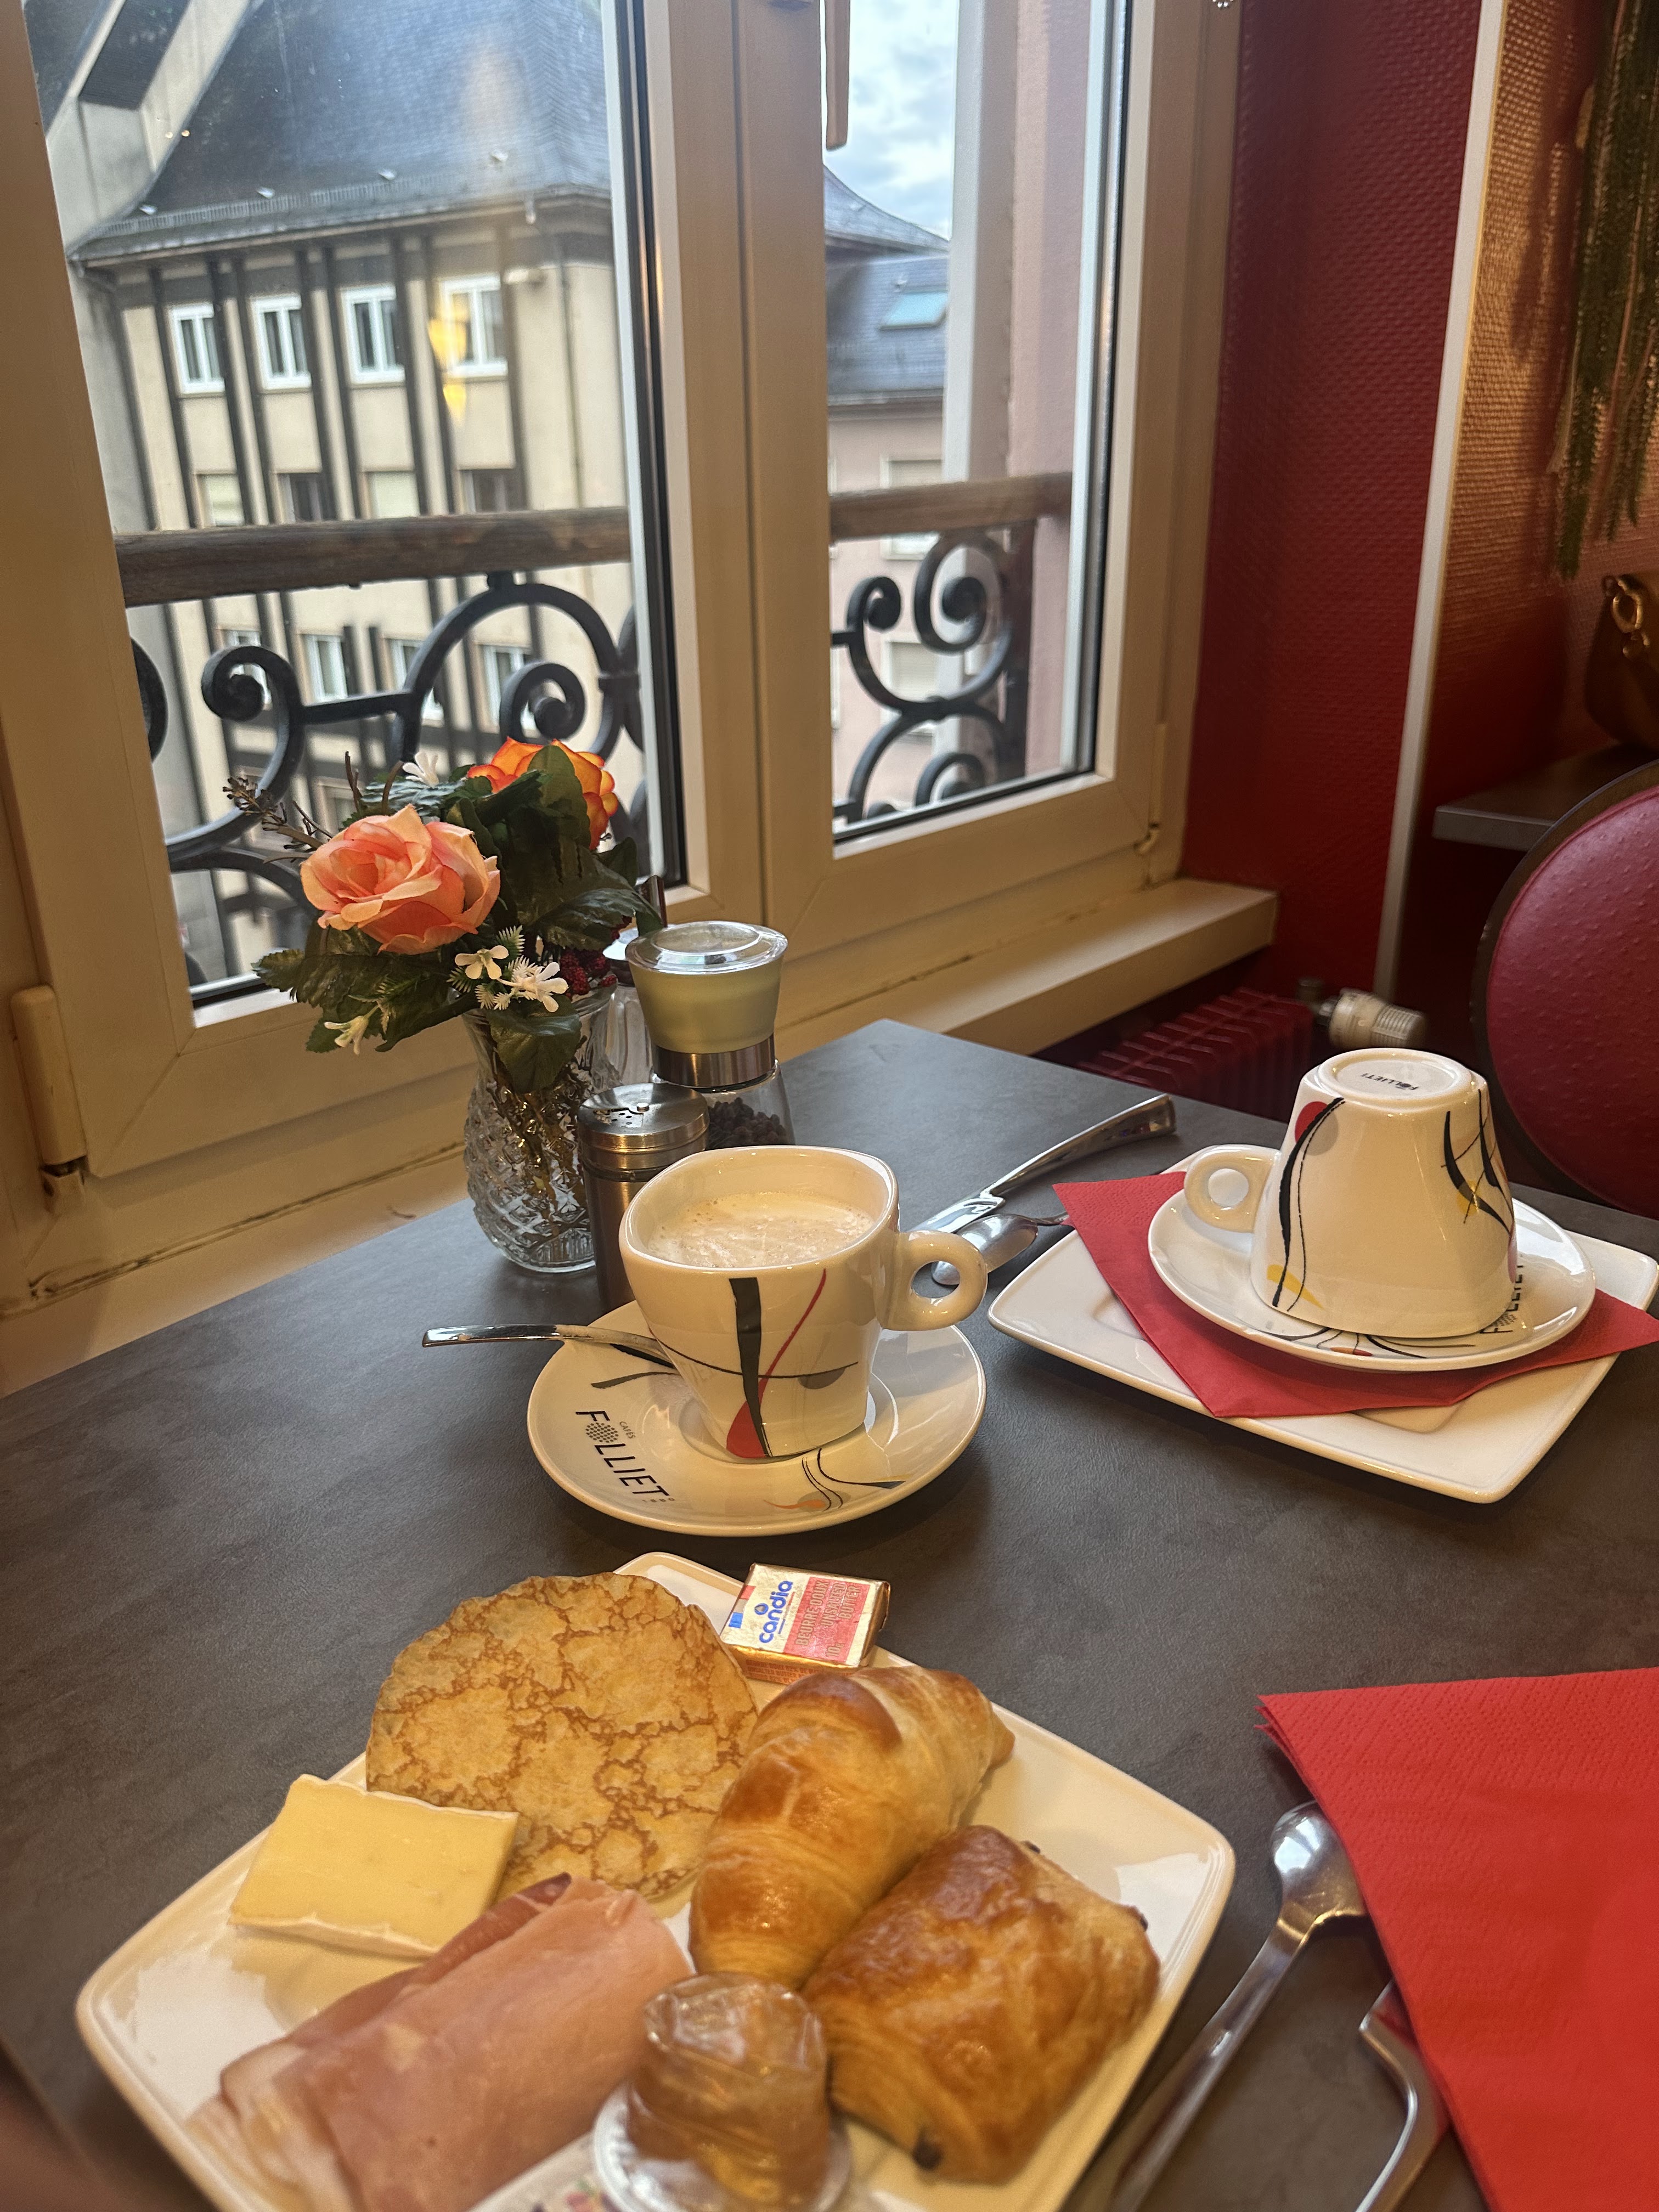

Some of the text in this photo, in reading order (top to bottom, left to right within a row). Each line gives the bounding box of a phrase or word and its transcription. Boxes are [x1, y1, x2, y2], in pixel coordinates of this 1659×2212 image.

[575, 1410, 670, 1497] FOLLIET
[759, 1580, 793, 1643] candia
[795, 1607, 820, 1646] BEURRE
[811, 1580, 831, 1605] DOUX
[821, 1583, 847, 1627] UNSALTED
[839, 1585, 861, 1619] BUTTER
